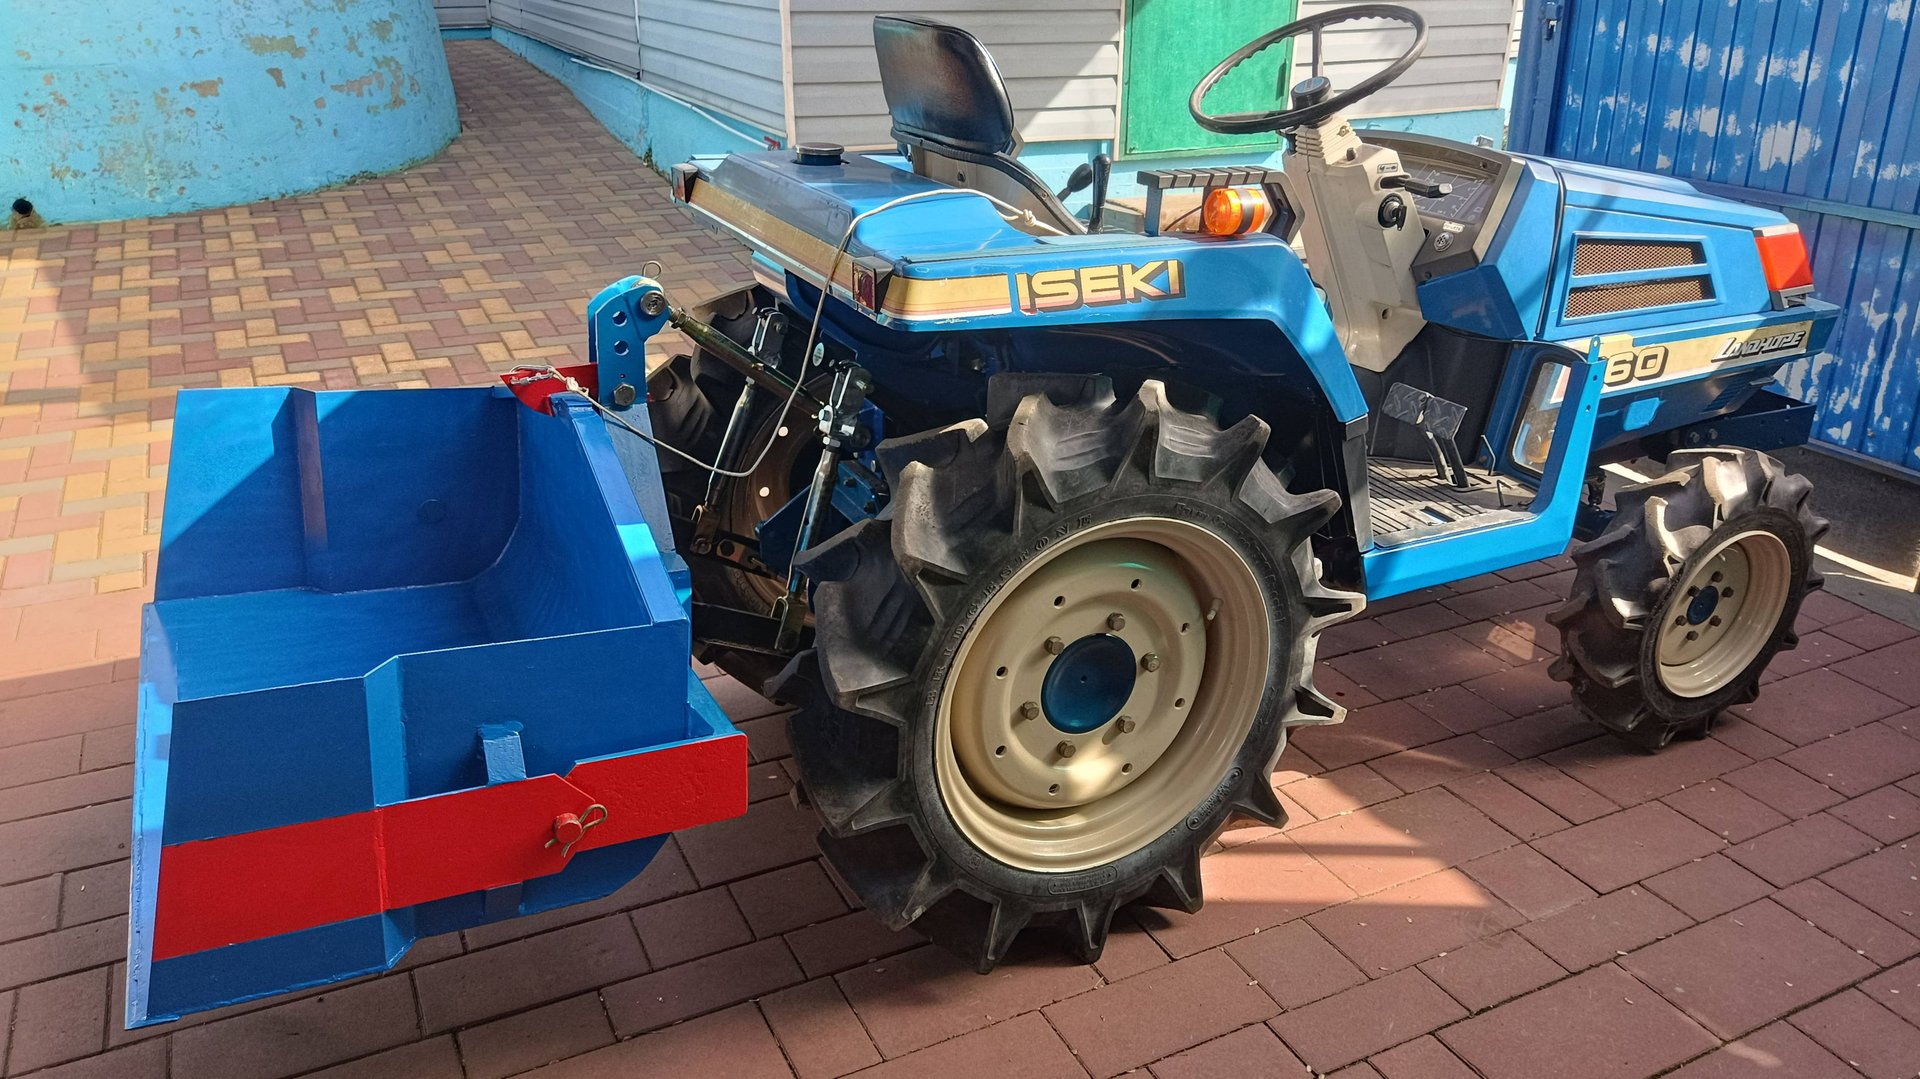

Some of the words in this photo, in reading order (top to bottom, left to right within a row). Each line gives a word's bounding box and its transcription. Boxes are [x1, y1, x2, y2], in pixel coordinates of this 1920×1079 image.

[1015, 259, 1186, 316] ISEKI
[1599, 345, 1669, 387] 60
[1711, 330, 1806, 363] LANDHOPE
[926, 514, 1092, 706] BRIDGESTONE
